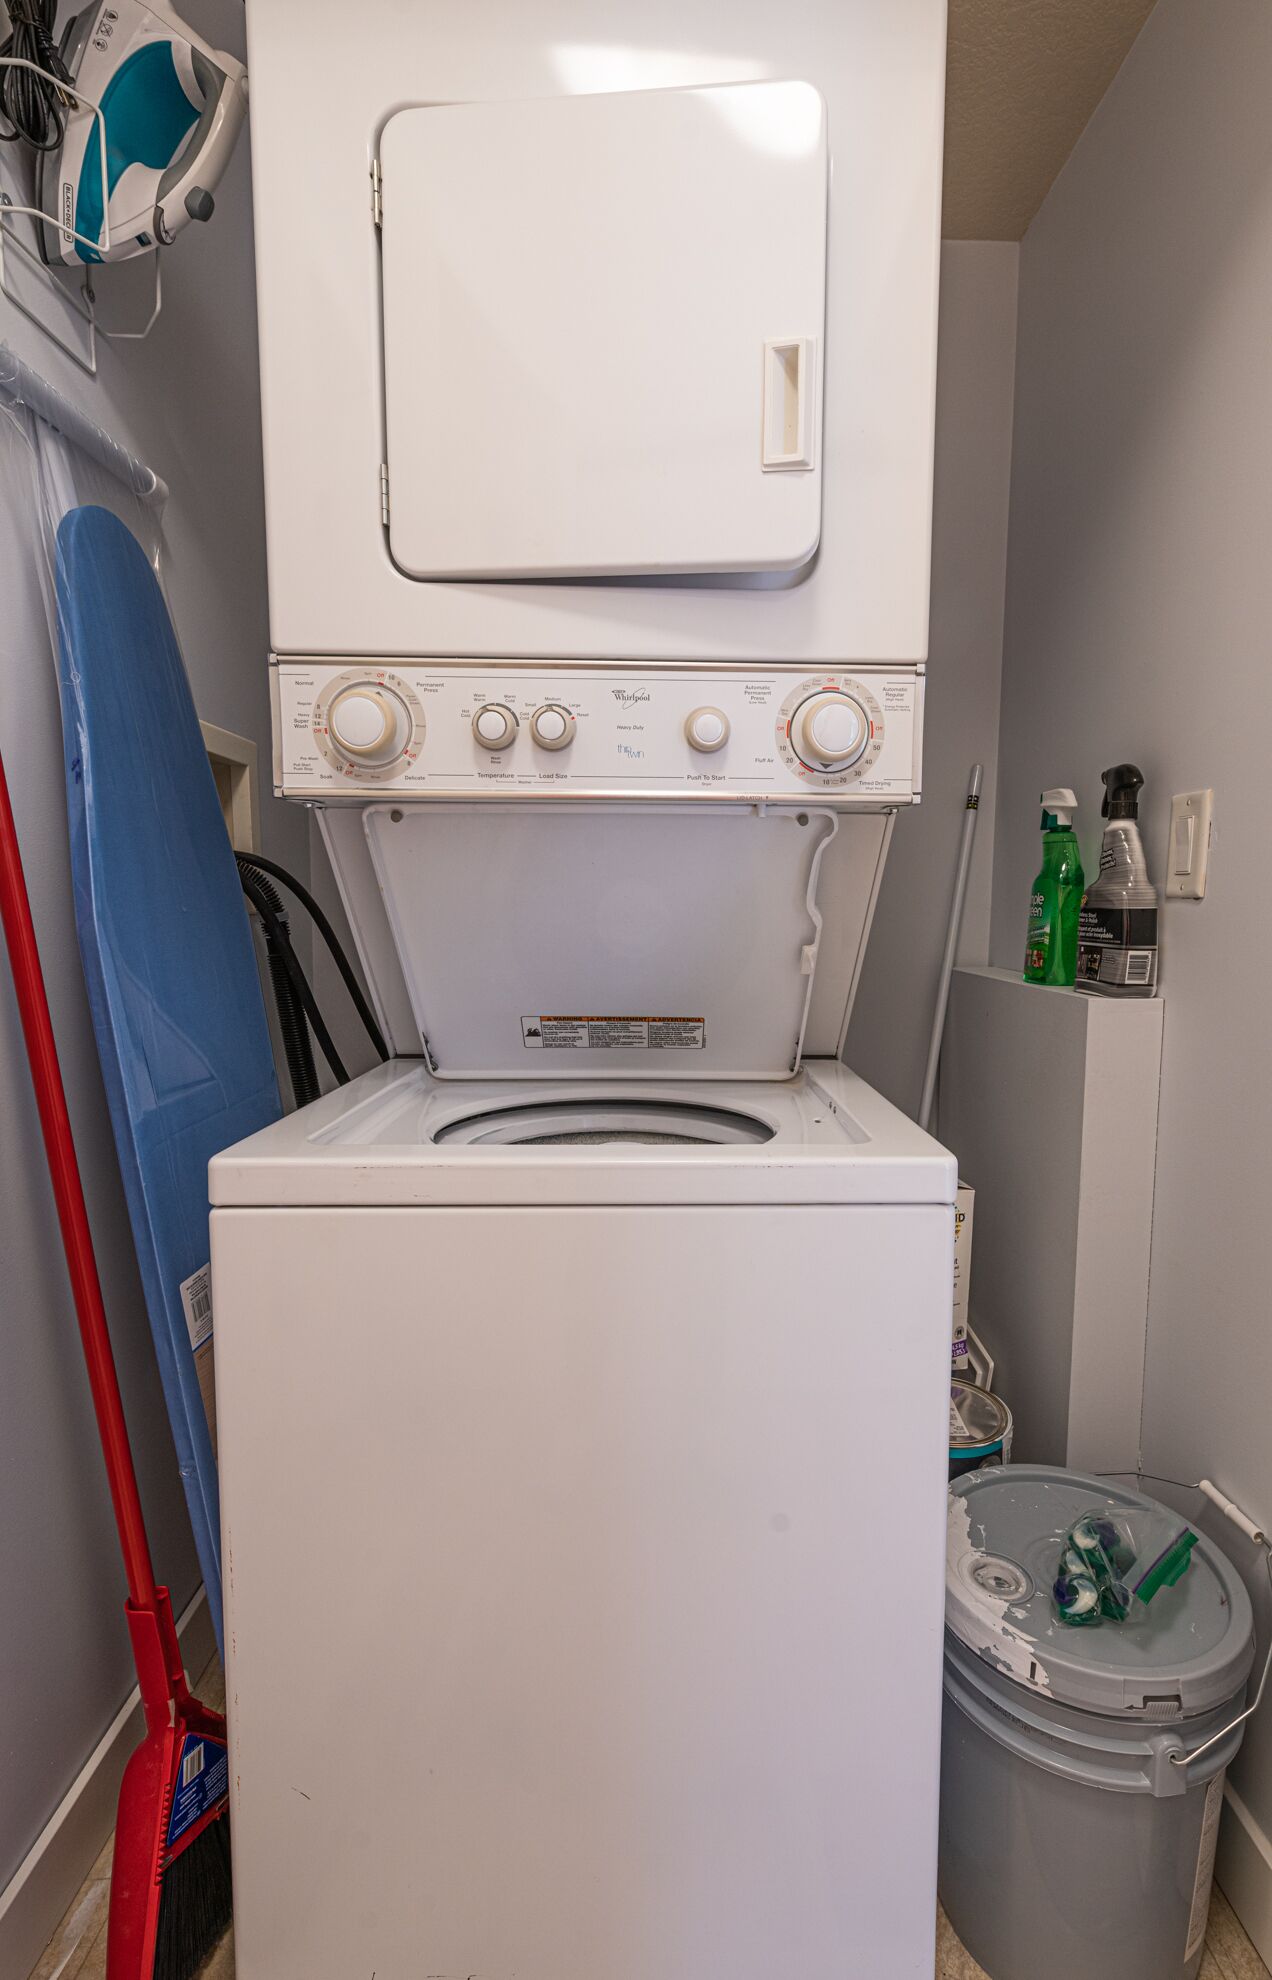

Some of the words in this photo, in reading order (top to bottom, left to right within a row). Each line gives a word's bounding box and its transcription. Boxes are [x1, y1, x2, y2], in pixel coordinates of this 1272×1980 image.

[614, 693, 651, 703] Whirlpool
[478, 772, 515, 780] Temperature
[875, 780, 891, 788] Drying
